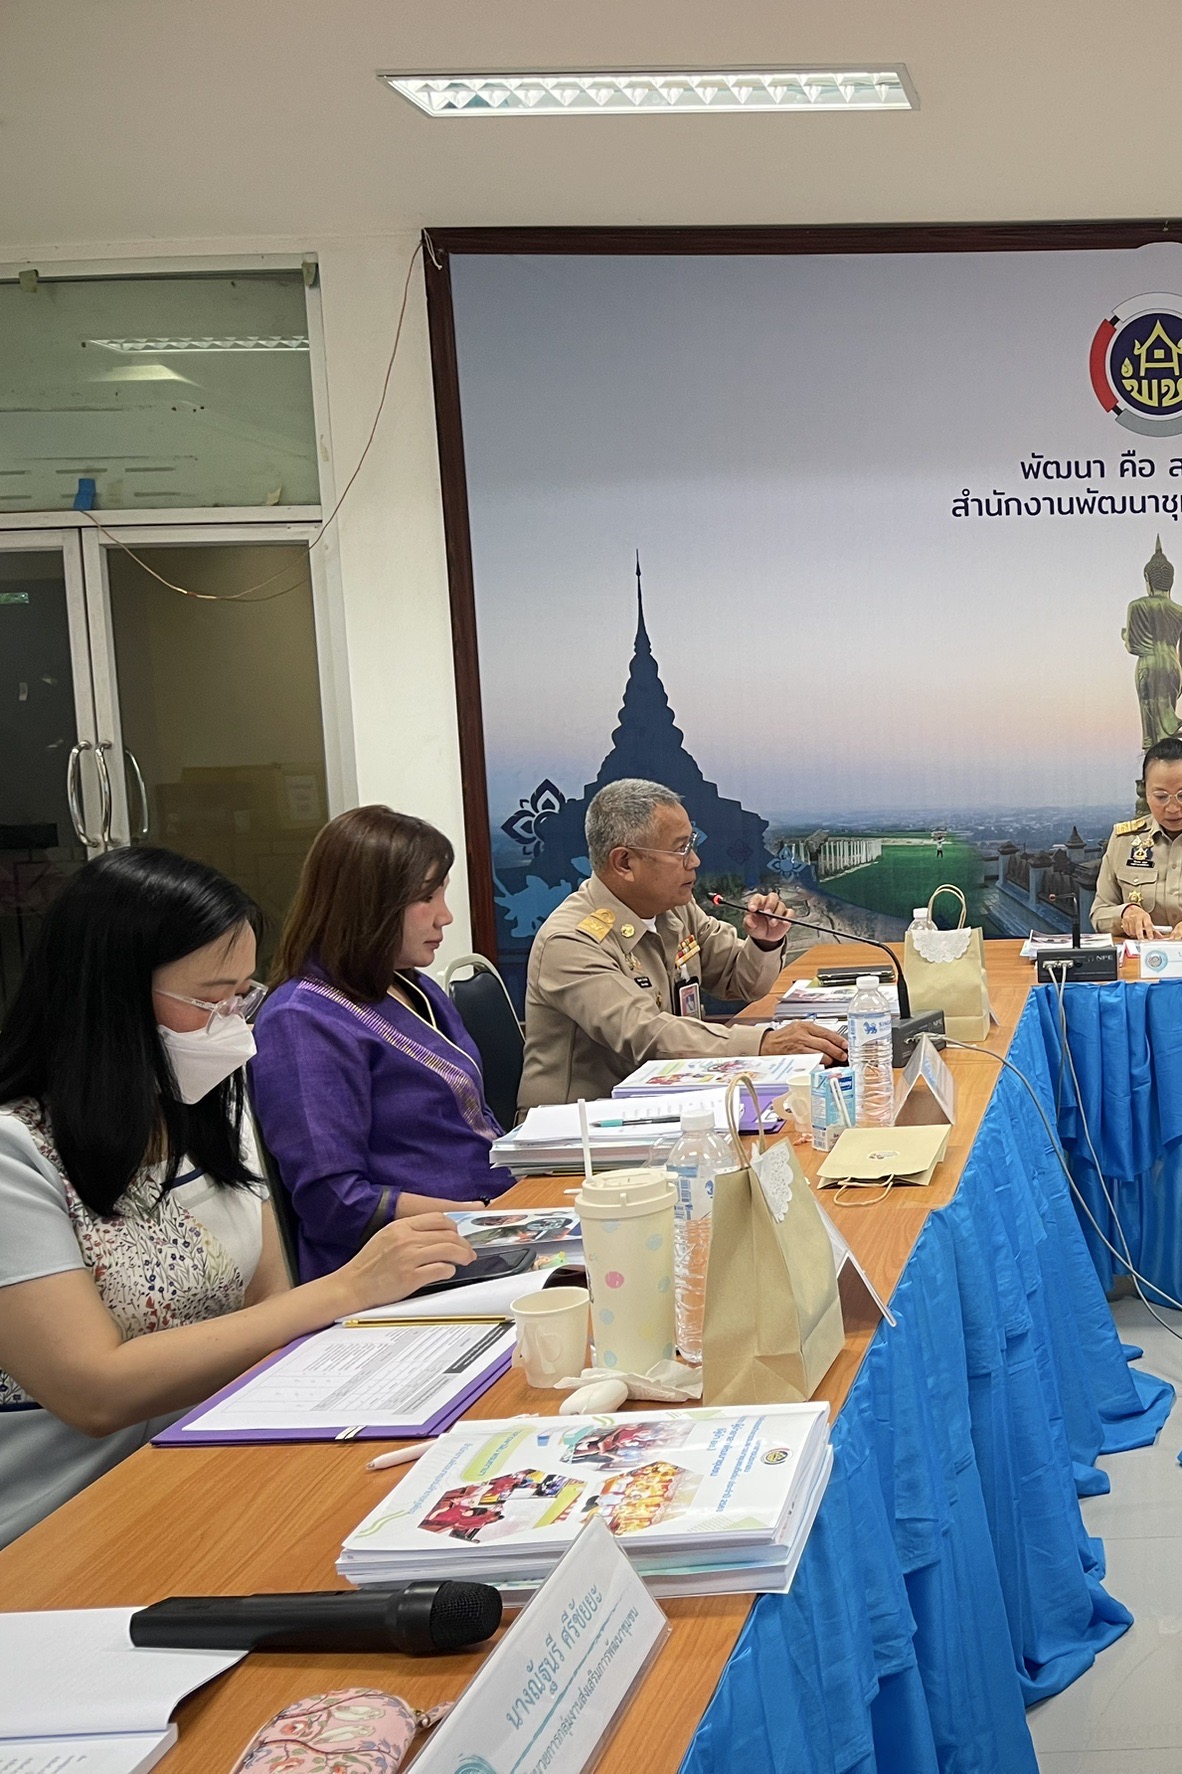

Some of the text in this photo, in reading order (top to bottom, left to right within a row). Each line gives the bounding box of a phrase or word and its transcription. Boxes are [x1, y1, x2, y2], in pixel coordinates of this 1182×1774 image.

[1020, 452, 1106, 480] พัฒนา
[1118, 449, 1156, 478] คือ
[561, 1585, 603, 1650] ศรีชัยยะ
